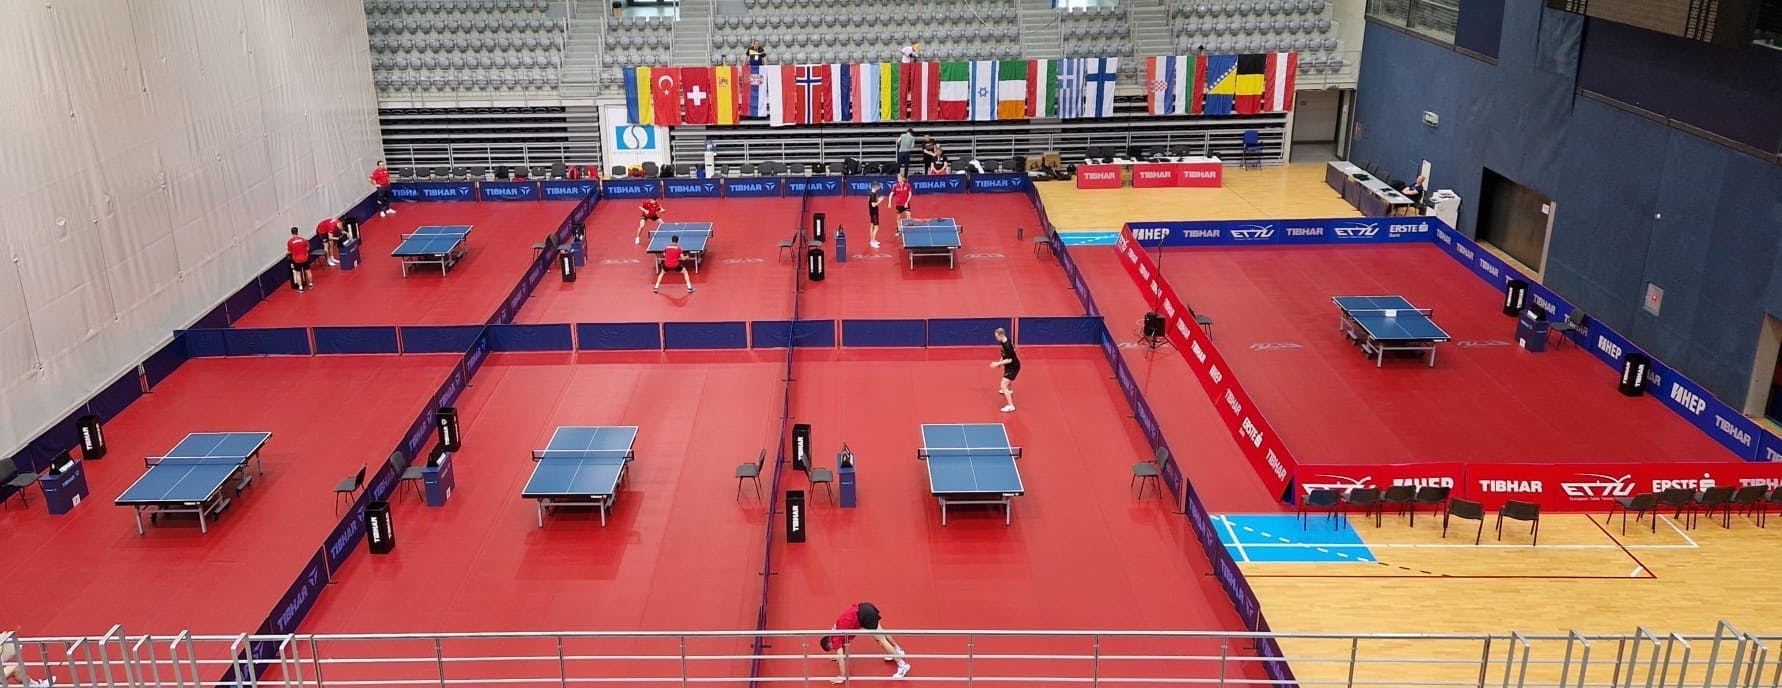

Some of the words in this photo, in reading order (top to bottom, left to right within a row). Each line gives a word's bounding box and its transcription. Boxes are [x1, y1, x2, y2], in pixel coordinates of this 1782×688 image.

[392, 188, 418, 196] TIBHA
[424, 188, 456, 196] TIBHAR
[546, 187, 578, 195] TIBHAR
[1286, 228, 1324, 236] TIBHAR
[1390, 224, 1418, 233] ERSTE
[1715, 414, 1752, 447] TIBHAR
[1266, 448, 1286, 482] TIBHAR
[1479, 480, 1542, 493] TIBHAR
[330, 520, 357, 559] TIBHAR
[371, 516, 380, 543] TIBHAR
[277, 584, 308, 631] TIBHAR
